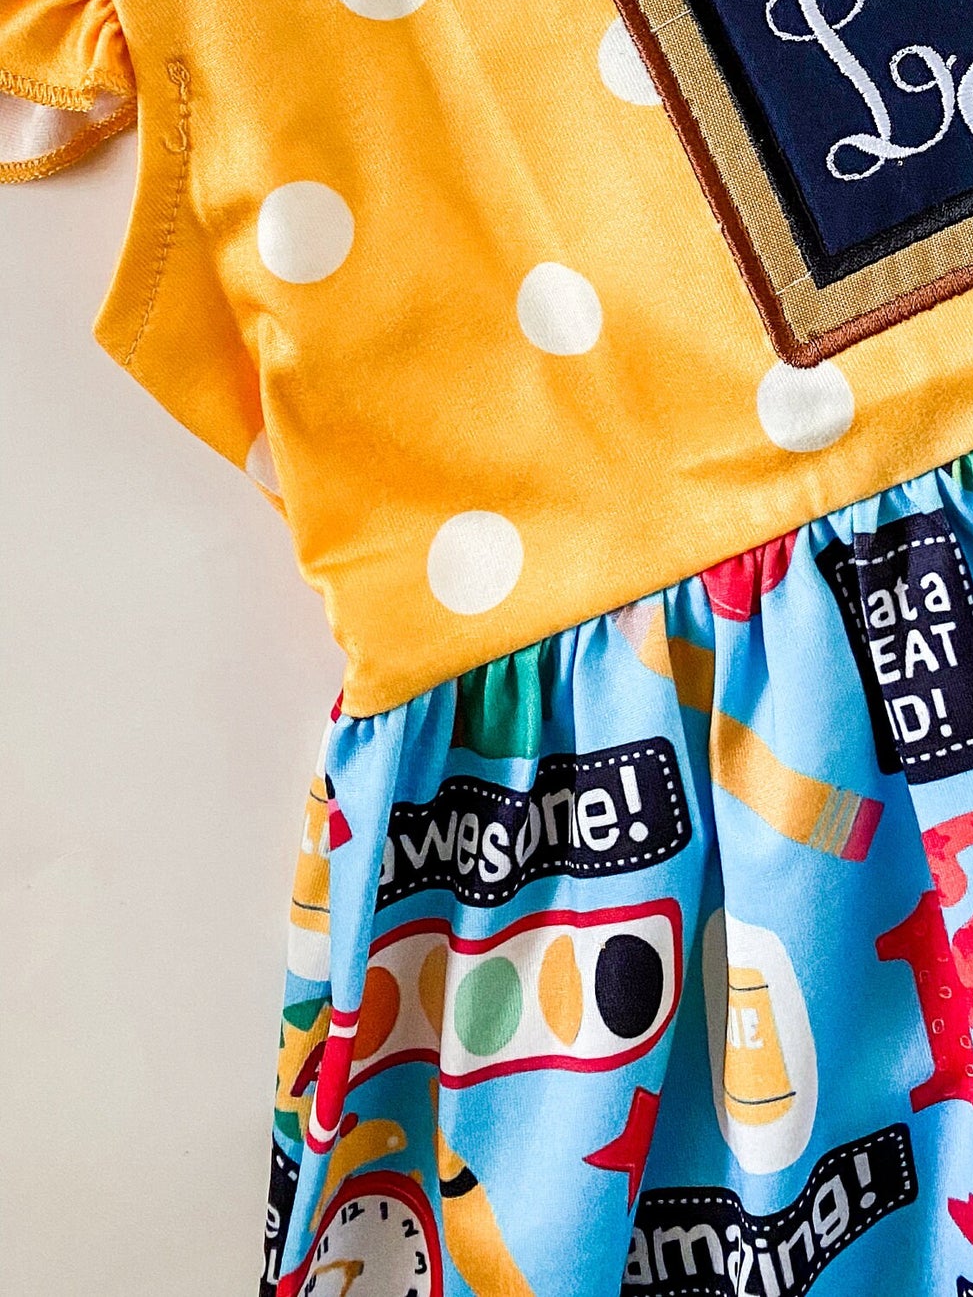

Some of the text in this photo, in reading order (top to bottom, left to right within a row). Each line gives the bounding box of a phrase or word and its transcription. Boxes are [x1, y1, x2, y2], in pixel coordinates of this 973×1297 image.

[341, 1201, 365, 1225] 12
[401, 1218, 420, 1238] 2
[414, 1250, 428, 1275] 3
